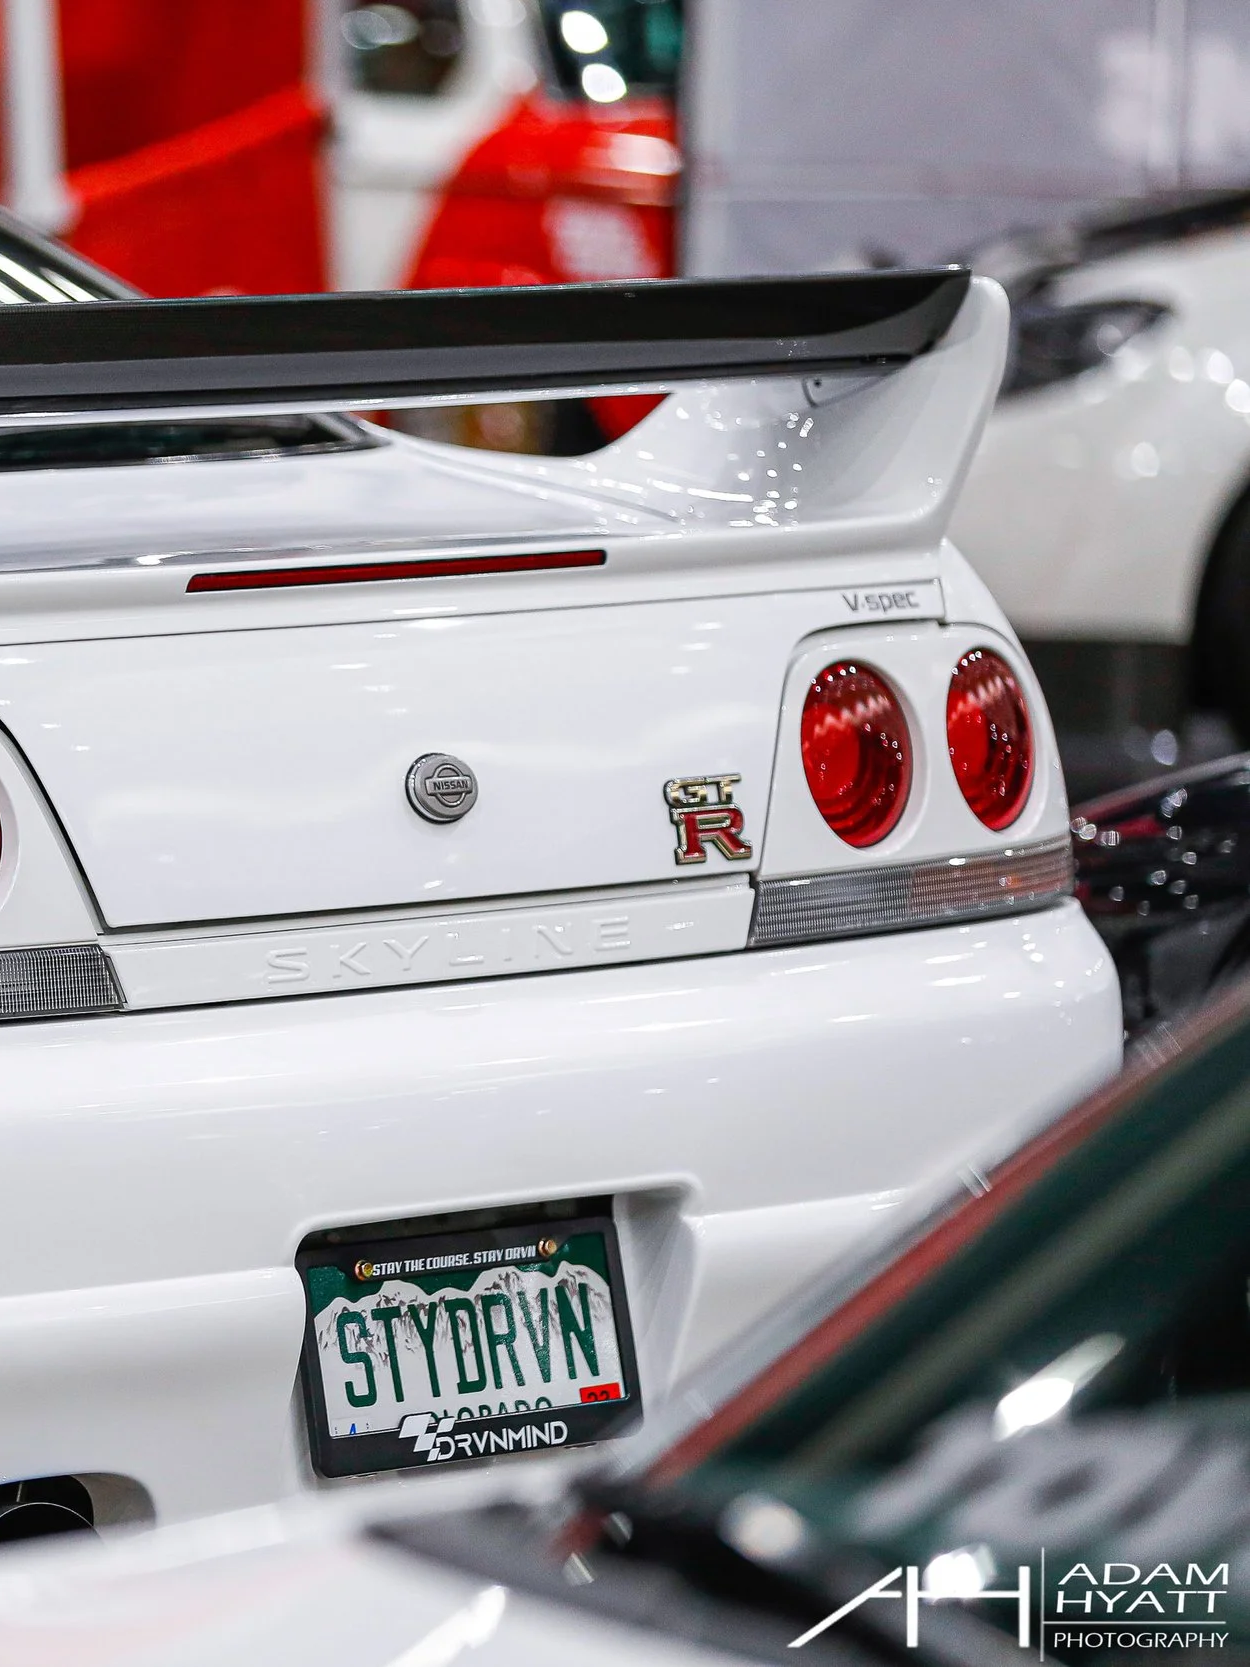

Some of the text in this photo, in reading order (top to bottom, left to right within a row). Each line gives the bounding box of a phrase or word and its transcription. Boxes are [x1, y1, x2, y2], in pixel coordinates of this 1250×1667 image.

[432, 780, 469, 791] NISSAN
[663, 772, 742, 808] GT
[670, 803, 752, 865] R
[264, 915, 632, 985] SKYLINE
[372, 1244, 537, 1276] STAY THE COURSE. STAY DRVN
[336, 1282, 600, 1408] STYDRVN
[434, 1420, 568, 1461] DRVNMIND
